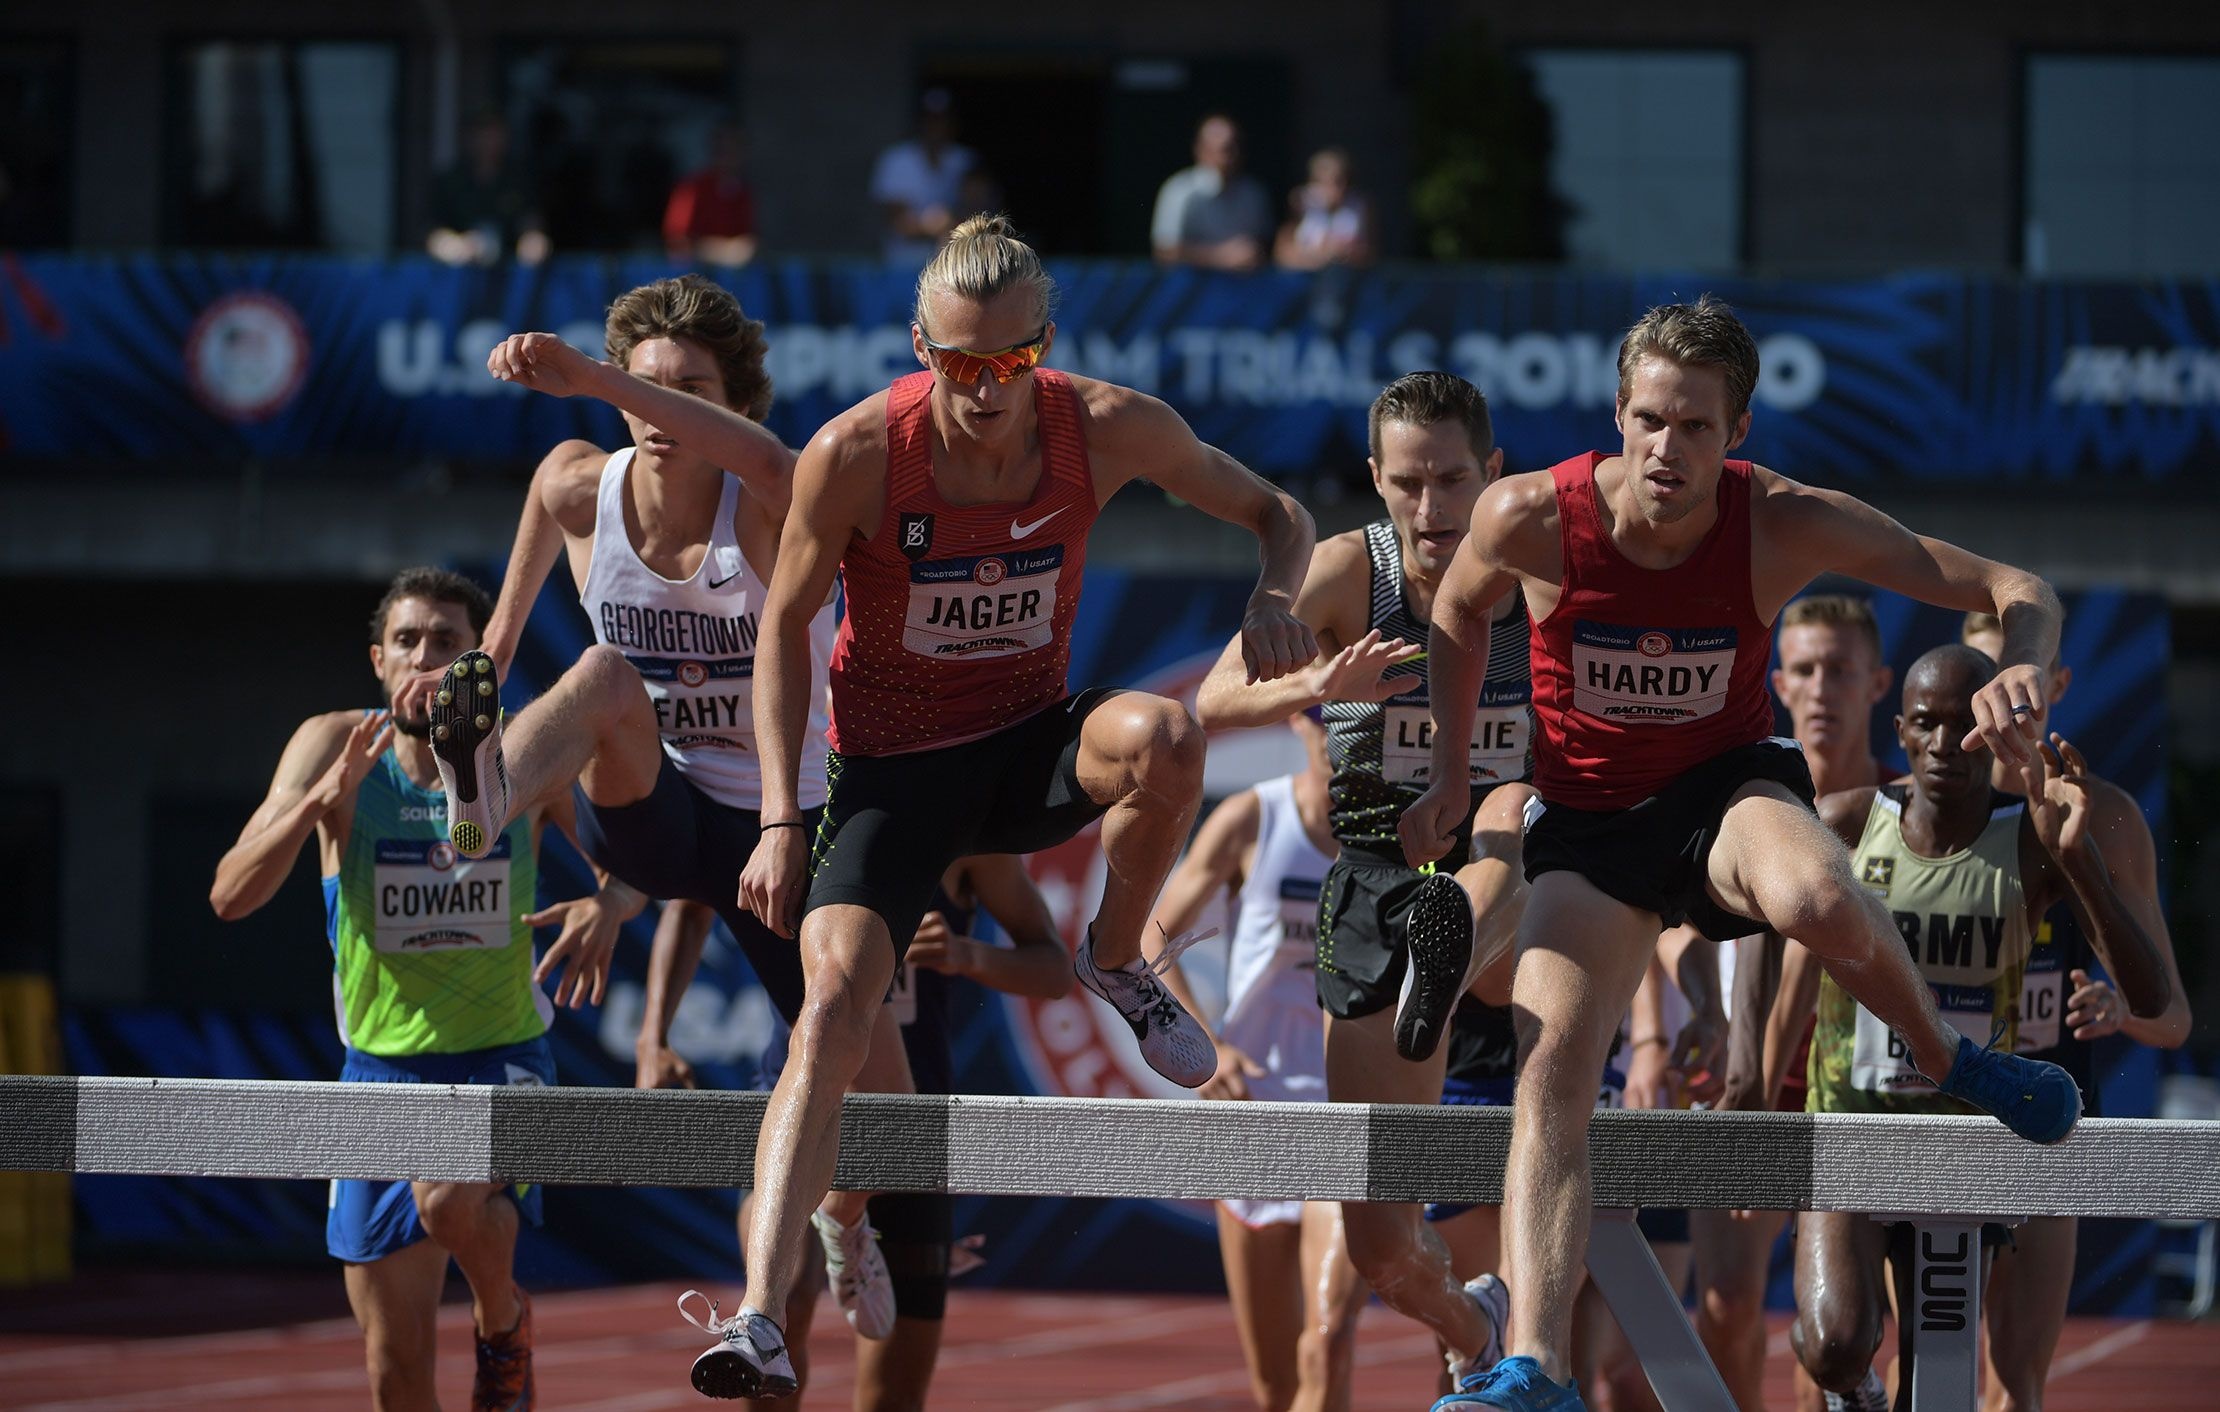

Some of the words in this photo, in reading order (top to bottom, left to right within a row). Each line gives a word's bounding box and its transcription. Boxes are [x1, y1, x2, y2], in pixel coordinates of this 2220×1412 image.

[1174, 329, 1438, 404] TRIALS
[1451, 330, 1620, 406] 201
[1029, 557, 1056, 569] USATF
[926, 589, 1041, 630] JAGER
[600, 601, 758, 656] GEORGETOWN
[1696, 638, 1727, 647] USATF
[1587, 660, 1720, 697] HARDY
[654, 695, 740, 729] FAHY
[1497, 693, 1523, 702] USATF
[1398, 720, 1516, 749] LEIE
[400, 804, 449, 822] sauc
[382, 879, 503, 917] COWART
[1891, 910, 2007, 968] RMY
[1921, 1231, 1969, 1331] UCS
